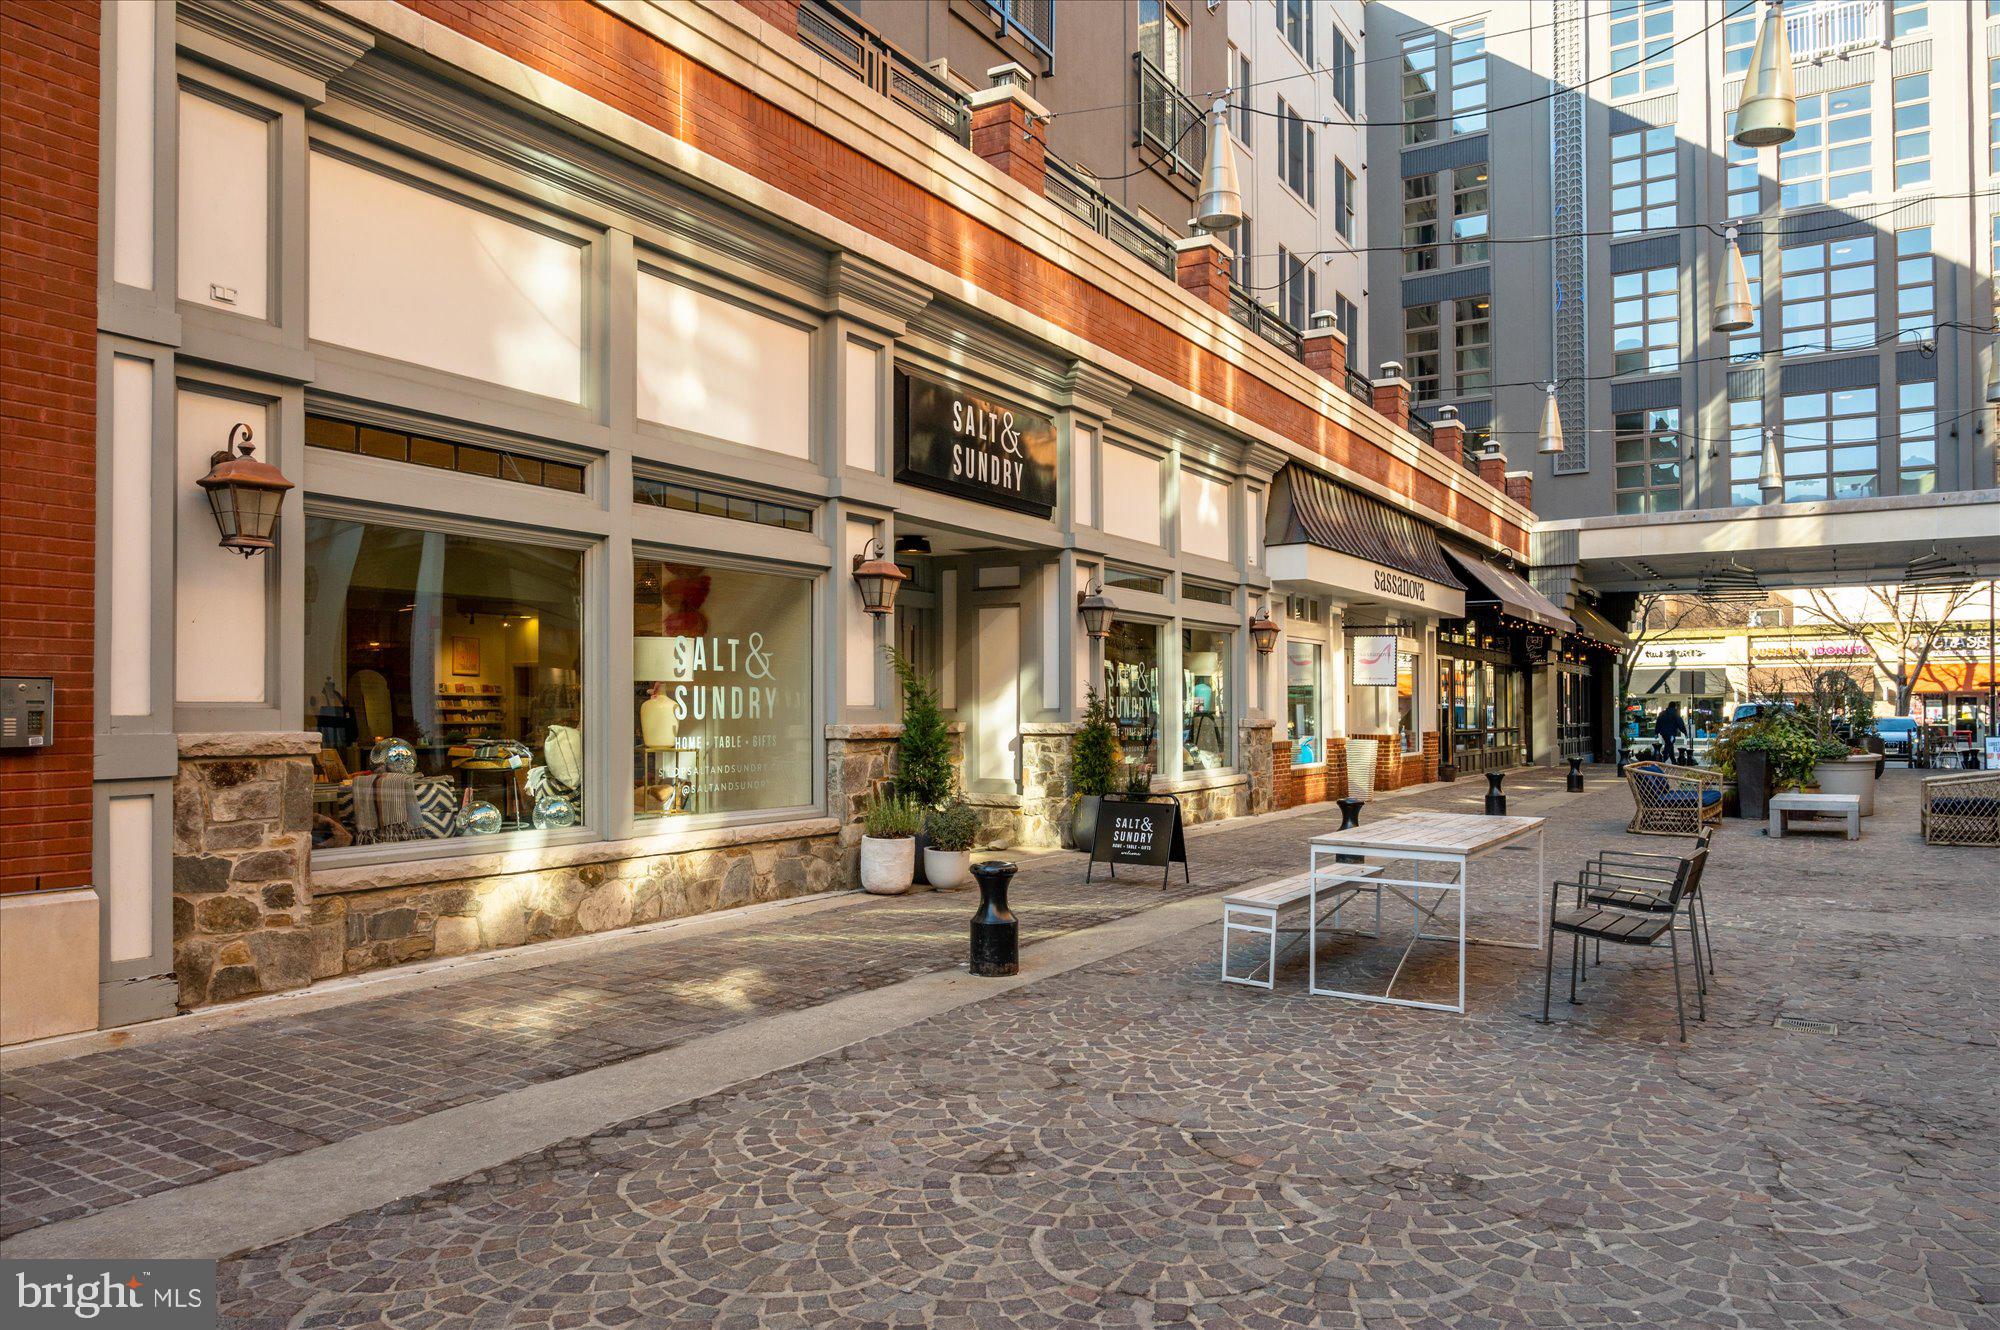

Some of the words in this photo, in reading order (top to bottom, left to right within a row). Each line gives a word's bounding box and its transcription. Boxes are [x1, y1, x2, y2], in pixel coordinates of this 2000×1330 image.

[953, 444, 1024, 492] SUNDRY
[1374, 569, 1426, 602] sassanova
[1817, 645, 1869, 656] DONUTS
[674, 685, 777, 720] SUNDRY
[1108, 696, 1151, 719] SUNDRY
[674, 736, 702, 750] HOME
[714, 735, 742, 748] TABLE
[752, 734, 777, 748] GIFTS
[1113, 830, 1154, 843] SUNDRY
